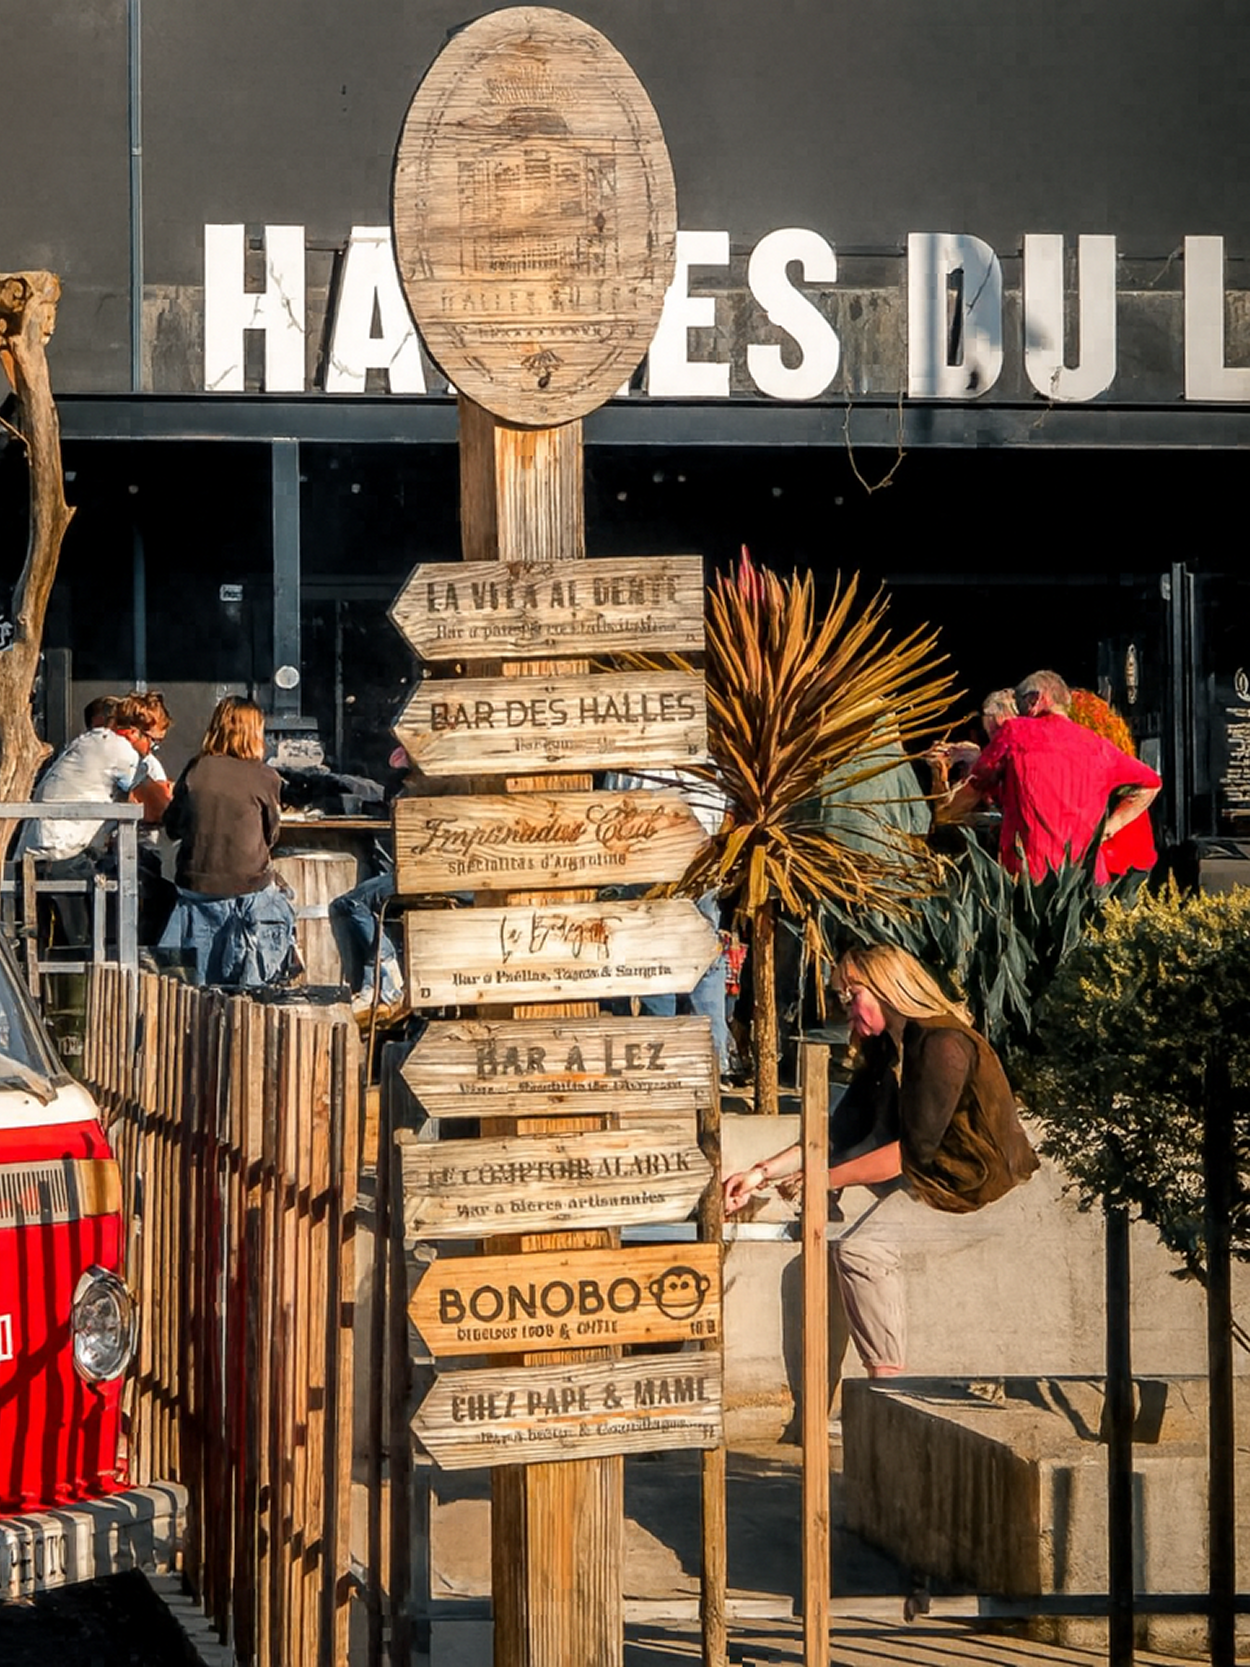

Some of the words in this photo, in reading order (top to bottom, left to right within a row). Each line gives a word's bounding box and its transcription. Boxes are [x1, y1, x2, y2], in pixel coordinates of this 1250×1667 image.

[907, 232, 1117, 400] DU
[431, 701, 494, 731] BAR
[506, 698, 567, 728] DES
[580, 693, 697, 724] HALLES
[475, 1040, 546, 1079] BAR
[604, 1036, 667, 1076] LEZ
[598, 1153, 692, 1180] ALARYK
[438, 1277, 642, 1325] BONOBO
[559, 1322, 571, 1341] &
[451, 1391, 517, 1423] CHEZ
[602, 1381, 623, 1410] &
